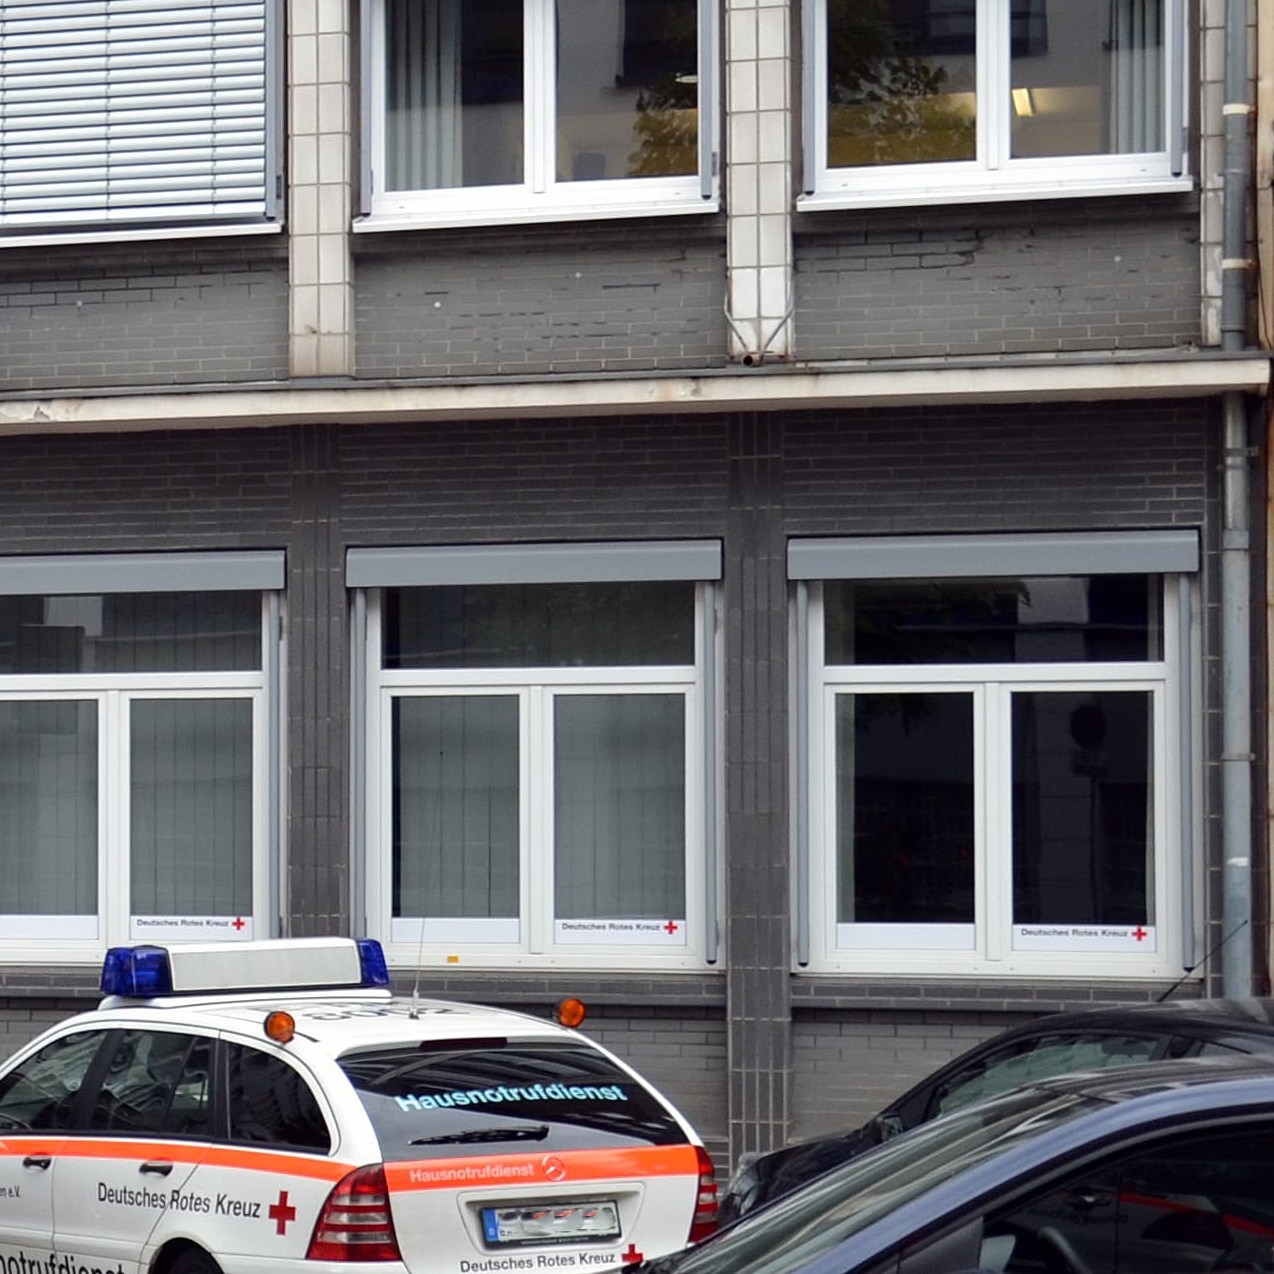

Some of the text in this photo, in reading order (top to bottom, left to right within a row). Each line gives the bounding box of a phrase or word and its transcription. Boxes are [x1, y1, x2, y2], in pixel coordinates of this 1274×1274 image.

[1021, 928, 1128, 937] Deutsches Rotes Kreuz
[394, 1082, 629, 1113] Hausnotrufdienst
[409, 1162, 535, 1184] Hausnotrufdienst
[97, 1181, 261, 1219] Deutsches Rotes Kreuz
[459, 1251, 617, 1273] Deutsches Rotes Kreuz
